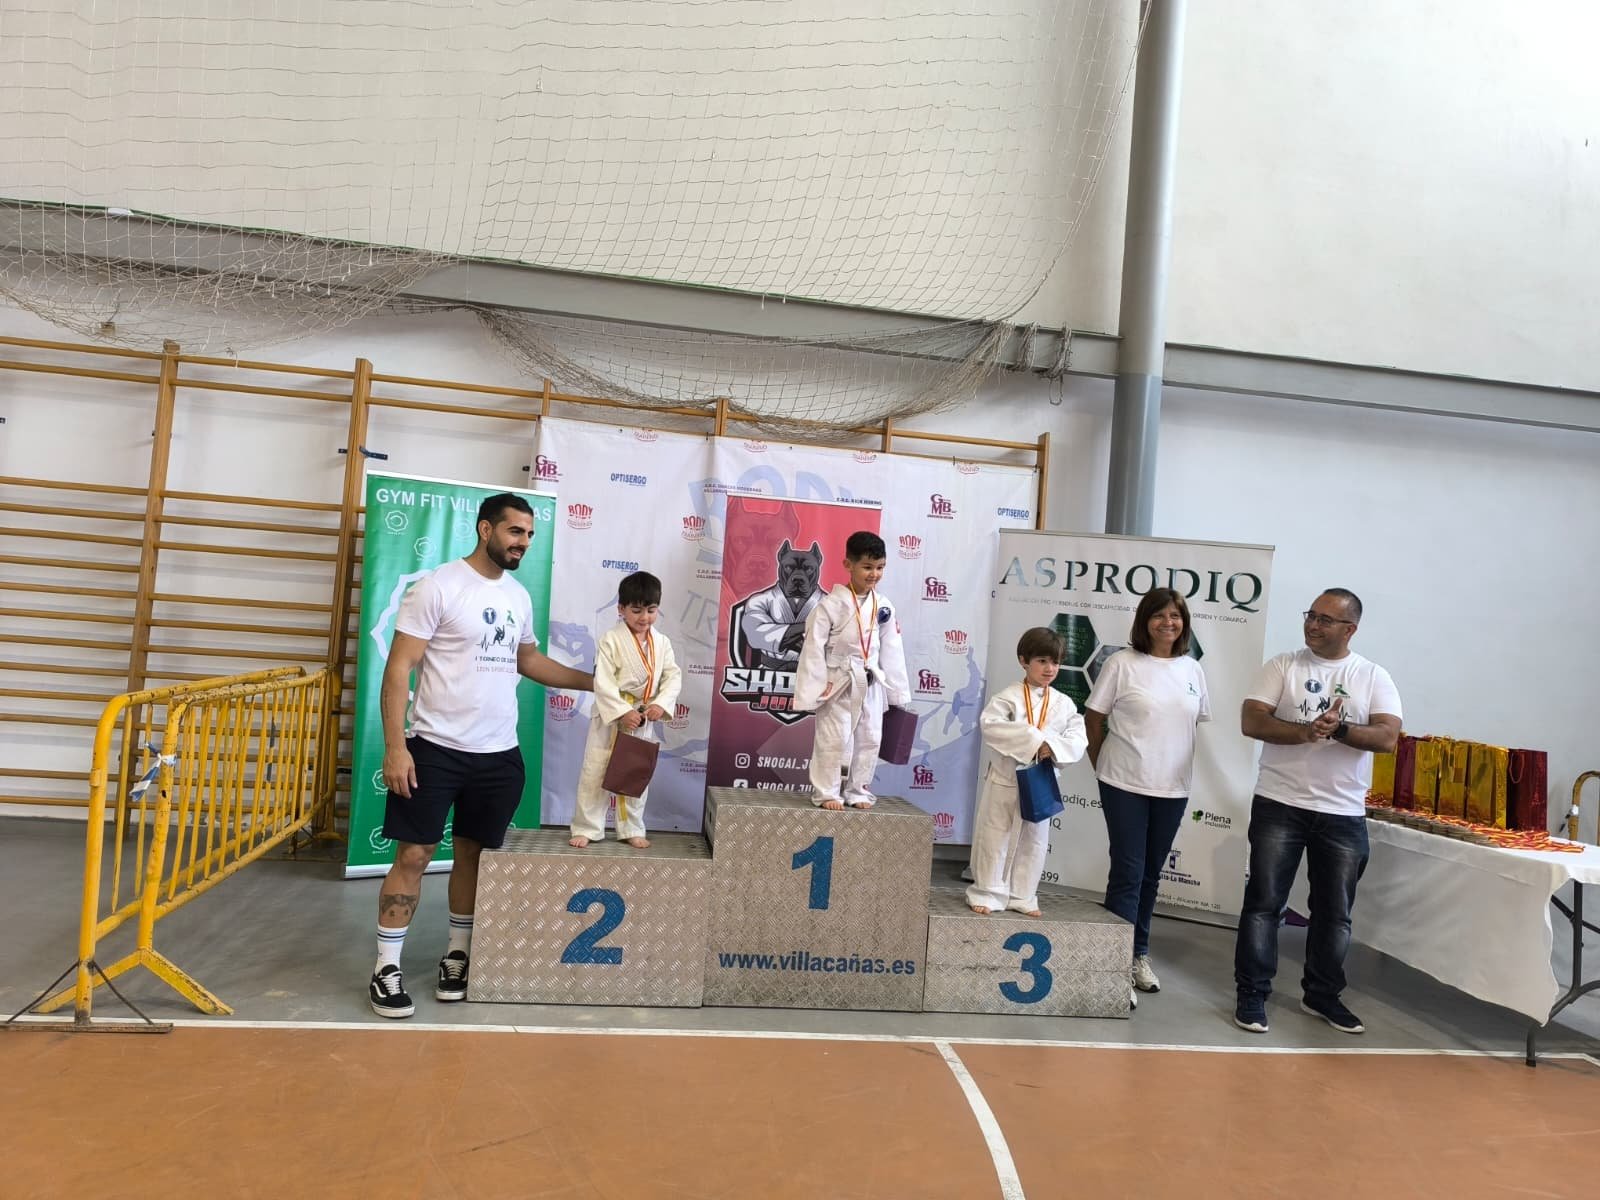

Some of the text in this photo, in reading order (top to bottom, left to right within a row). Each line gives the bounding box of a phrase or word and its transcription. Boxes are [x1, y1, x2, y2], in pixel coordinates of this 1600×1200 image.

[610, 472, 648, 485] OPTISERGO
[376, 488, 415, 506] GYM
[420, 493, 446, 510] FIT
[997, 507, 1030, 519] OPTISERGO
[602, 559, 639, 571] OPTISERGO
[999, 556, 1263, 613] ASPRODIQ
[1205, 812, 1232, 825] Plena
[791, 836, 834, 910] 1
[560, 887, 626, 965] 2
[718, 952, 916, 975] www.villacañas.es
[997, 931, 1054, 1004] 3
